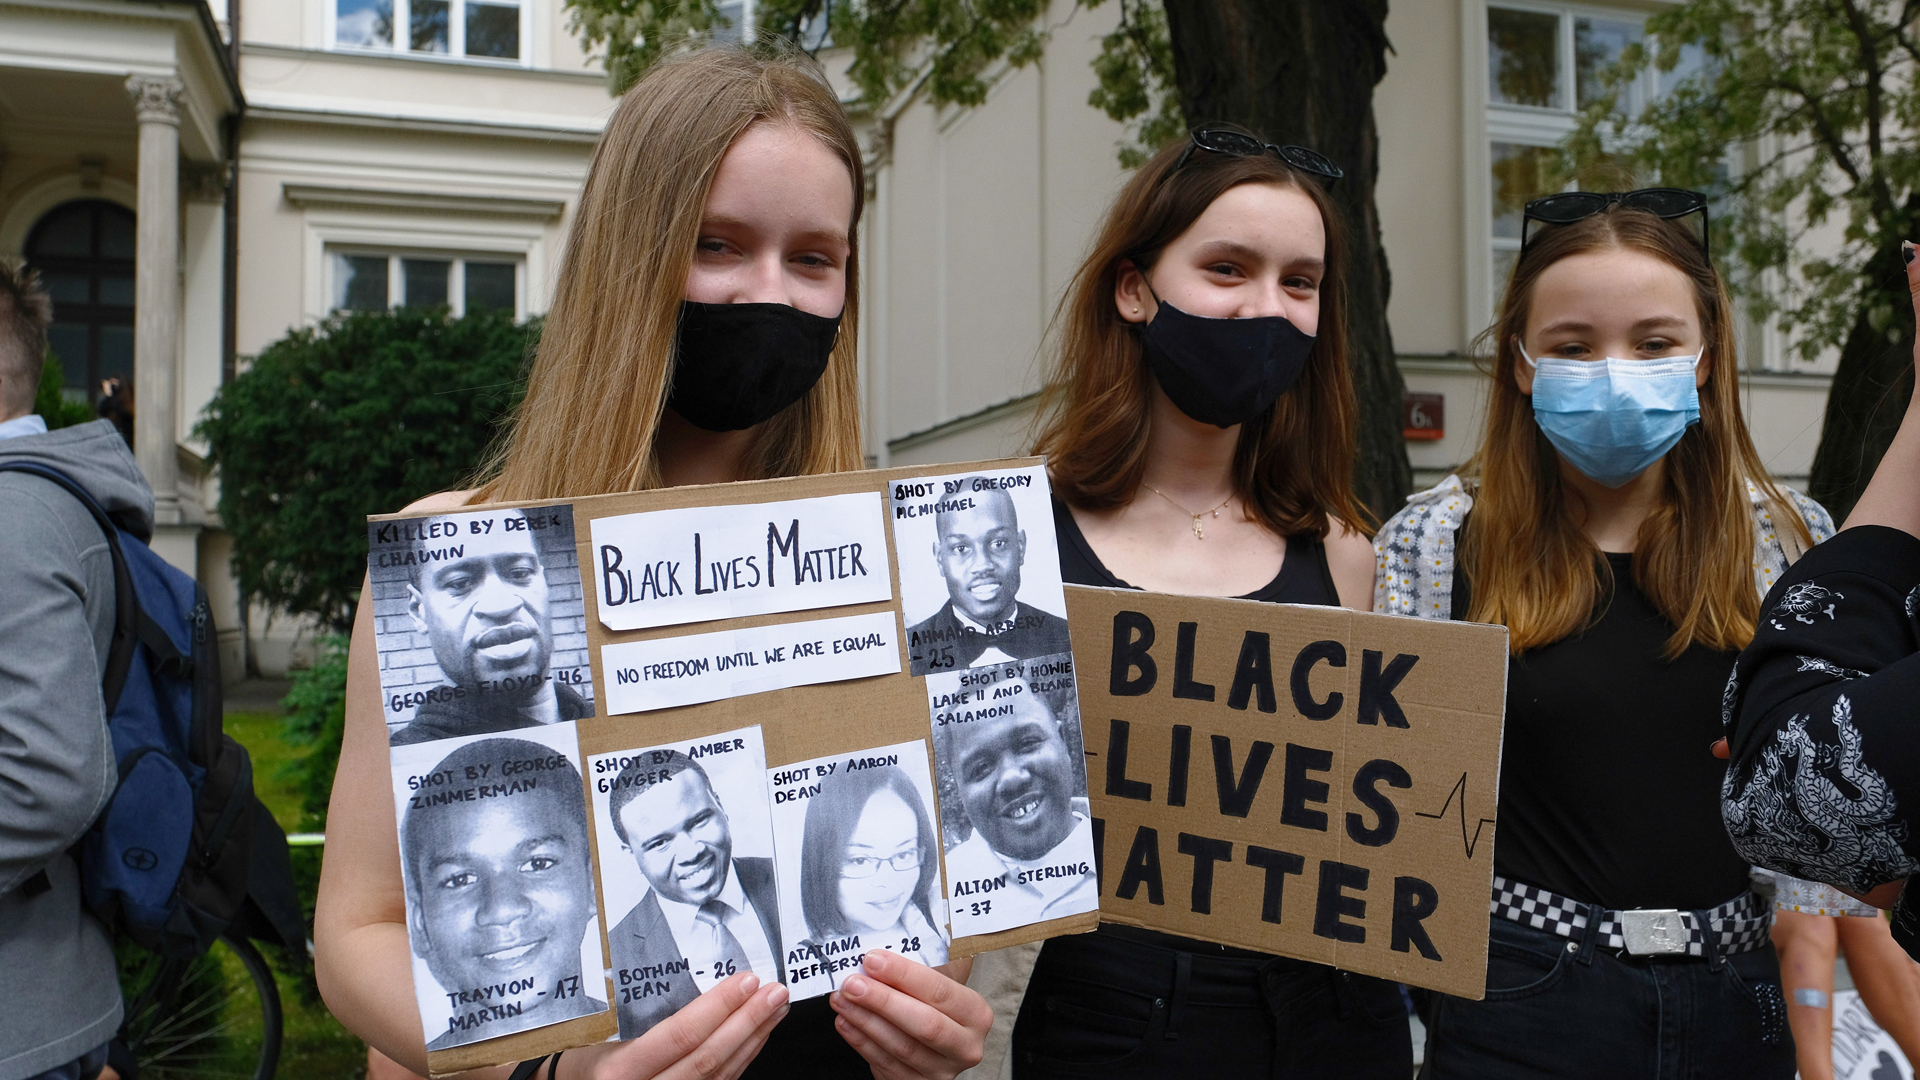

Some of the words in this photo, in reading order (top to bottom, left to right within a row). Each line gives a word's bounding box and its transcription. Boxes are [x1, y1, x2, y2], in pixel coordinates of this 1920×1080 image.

[895, 483, 934, 500] SHOT
[944, 479, 963, 494] BY
[972, 475, 1032, 492] GREGORY
[377, 522, 458, 544] KILLED
[470, 519, 494, 535] BY
[504, 514, 560, 532] DEREK
[378, 544, 464, 568] CHAUVIN
[600, 544, 683, 606] BLACK
[694, 532, 760, 595] LIVES
[768, 519, 868, 587] MATTER
[986, 616, 1046, 636] ARBERY
[617, 668, 639, 685] NO
[644, 658, 710, 680] FREEDOM
[717, 652, 759, 671] UNTIL
[764, 647, 786, 662] WE
[792, 642, 824, 660] ARE
[833, 633, 886, 654] EQUAL
[930, 646, 955, 668] 25
[1110, 610, 1420, 729] BLACK
[961, 671, 998, 687] SHOT
[1006, 666, 1024, 679] BY
[1031, 662, 1072, 676] HOWIE
[391, 685, 466, 713] GEORGE
[933, 692, 970, 708] LAKE
[993, 684, 1022, 700] AND
[1030, 678, 1072, 694] BLANE
[936, 704, 1014, 726] SALAMONI
[595, 756, 642, 774] SHOT
[652, 750, 675, 764] BY
[688, 738, 744, 760] AMBER
[773, 769, 810, 786] SHOT
[816, 762, 837, 776] BY
[846, 754, 898, 774] AARON
[408, 771, 454, 790] SHOT
[466, 763, 490, 780] BY
[502, 754, 569, 776] GEORGE
[1106, 719, 1412, 847] LIVES
[410, 778, 538, 810] ZIMMERMAN
[774, 783, 822, 804] DEAN
[954, 876, 1006, 897] ALTON
[1018, 862, 1089, 885] STERLING
[971, 900, 992, 916] 37
[788, 936, 861, 964] ATATIANA
[901, 936, 921, 954] 28
[619, 958, 690, 985] BOTHAM
[714, 959, 736, 980] 26
[790, 954, 866, 984] JEFFERS
[447, 977, 534, 1008] TRAYVON
[554, 976, 580, 999] 17
[619, 981, 670, 1004] JEAN
[448, 1002, 523, 1034] MARTIN
